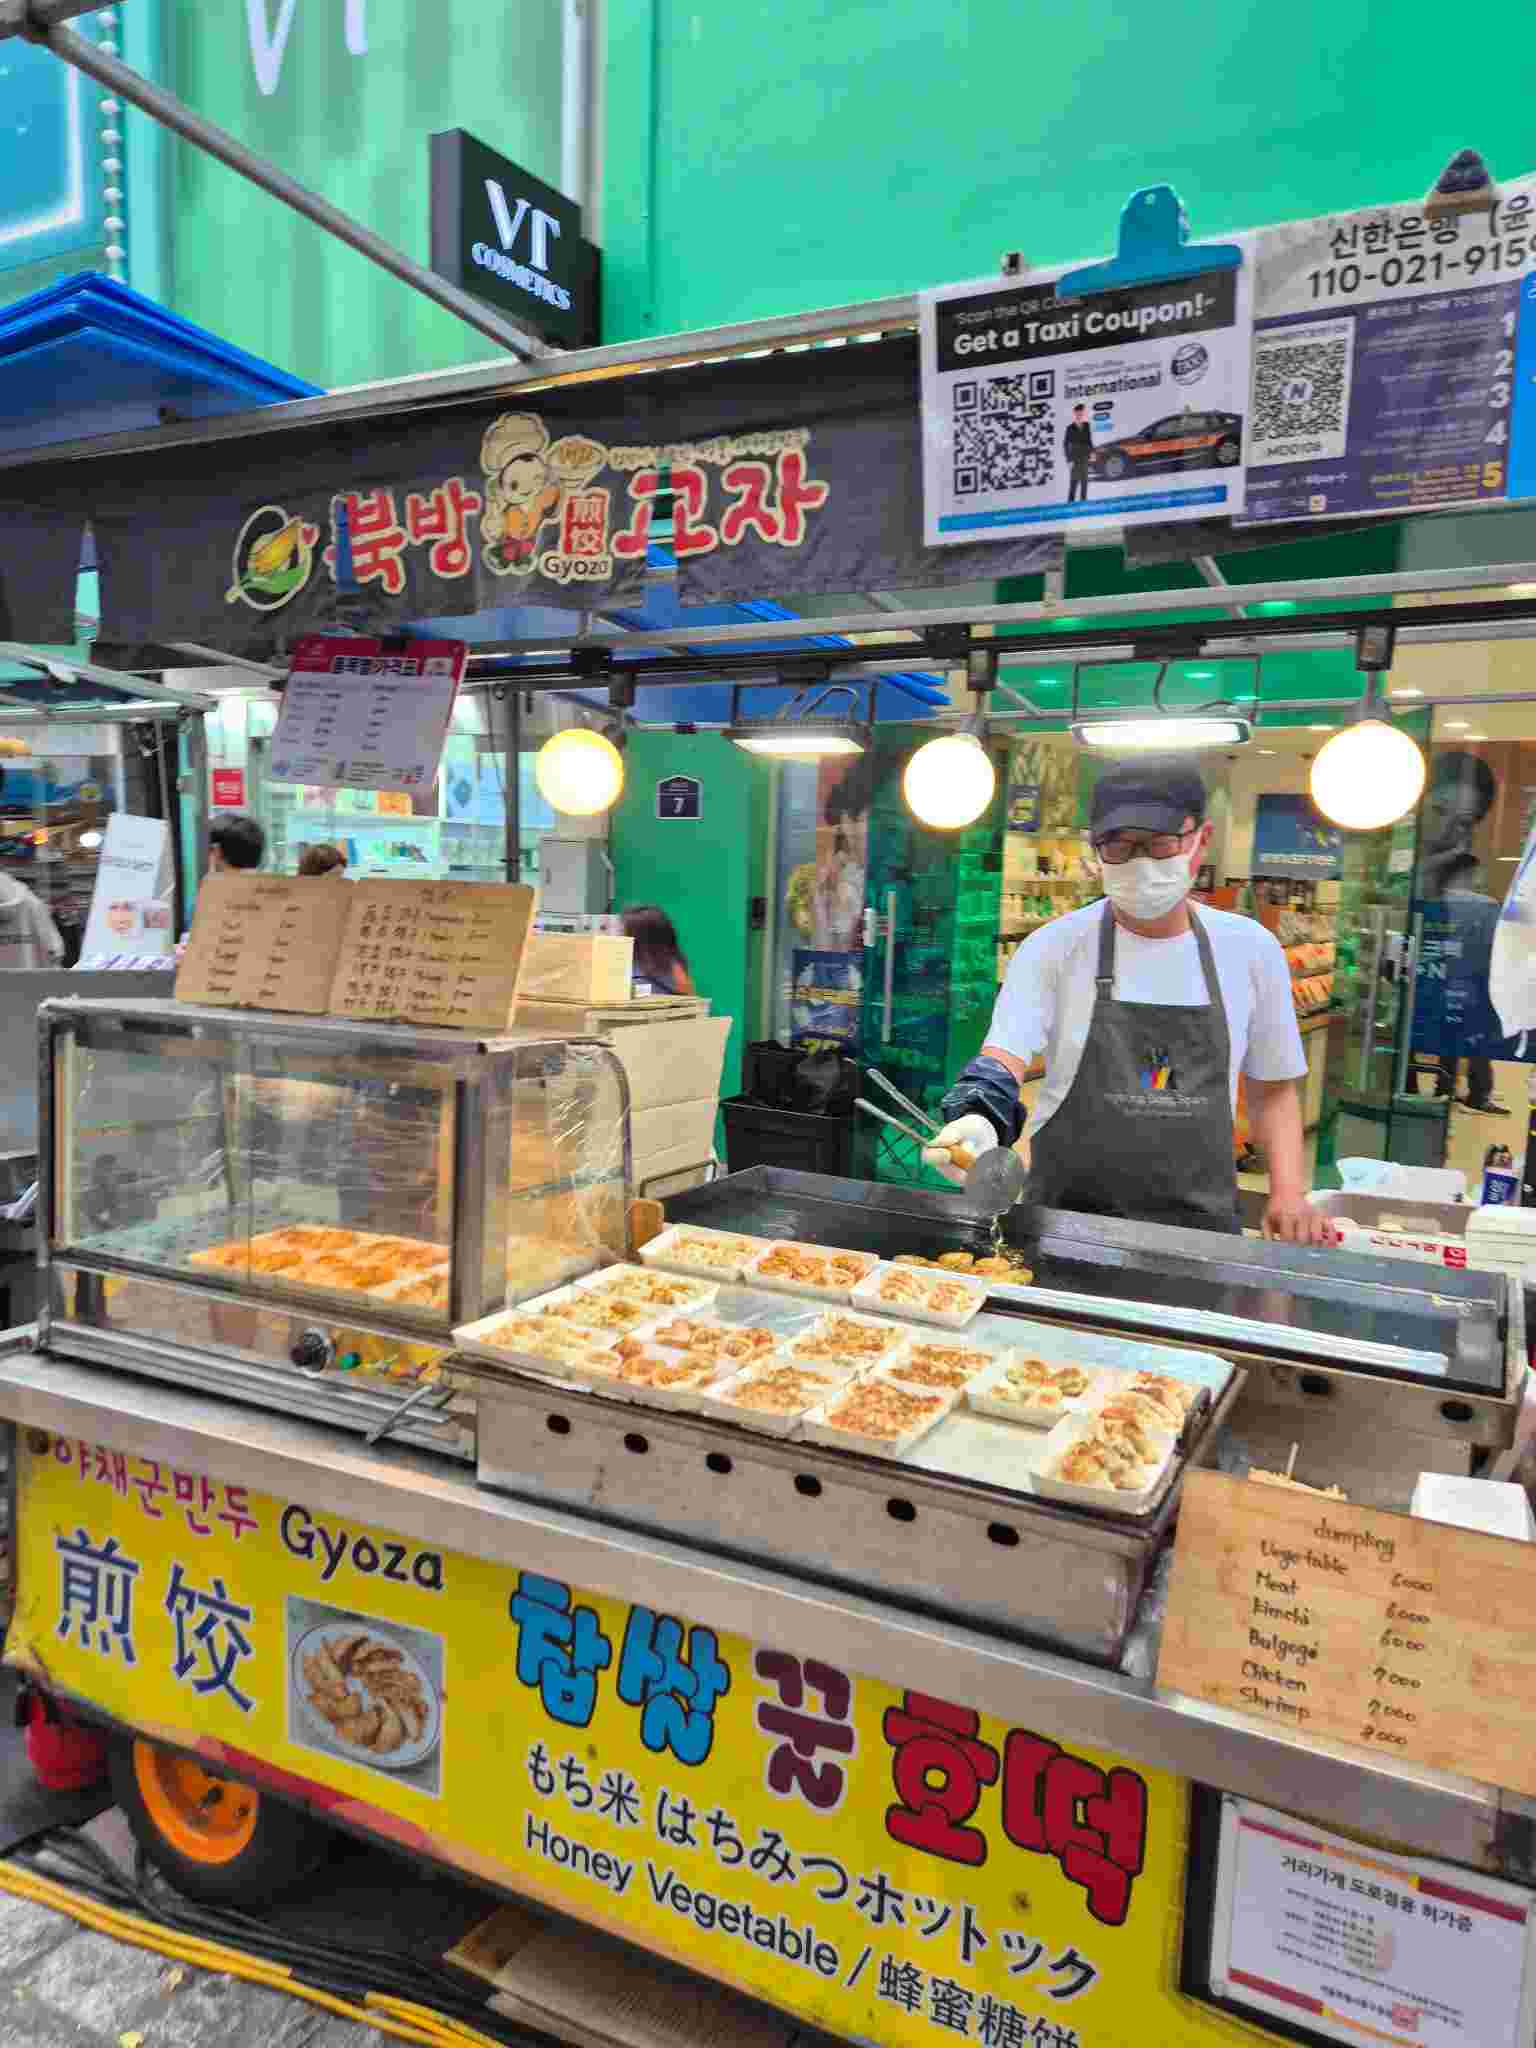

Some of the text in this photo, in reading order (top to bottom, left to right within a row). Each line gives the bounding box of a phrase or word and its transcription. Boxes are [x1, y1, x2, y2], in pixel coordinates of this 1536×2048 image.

[485, 178, 561, 272] VT
[953, 329, 998, 355] Get
[1002, 328, 1020, 347] a
[1024, 313, 1079, 345] Taxi
[1493, 350, 1513, 376] 2
[1484, 420, 1508, 445] 4
[1488, 382, 1510, 408] 3
[1482, 461, 1503, 488] 5
[323, 478, 481, 592] 북방
[612, 448, 827, 559] 교자
[543, 555, 609, 578] Gyoza
[55, 1438, 259, 1540] 야채군만두
[281, 1504, 444, 1591] Gyoza
[55, 1528, 255, 1712] 煎饺
[1379, 1628, 1425, 1651] 6000
[510, 1571, 1148, 1927] 찹쌀 꿀 호떡
[527, 1743, 640, 1825] もち米
[526, 1813, 633, 1893] Honey
[646, 1861, 840, 1976] Vegetable
